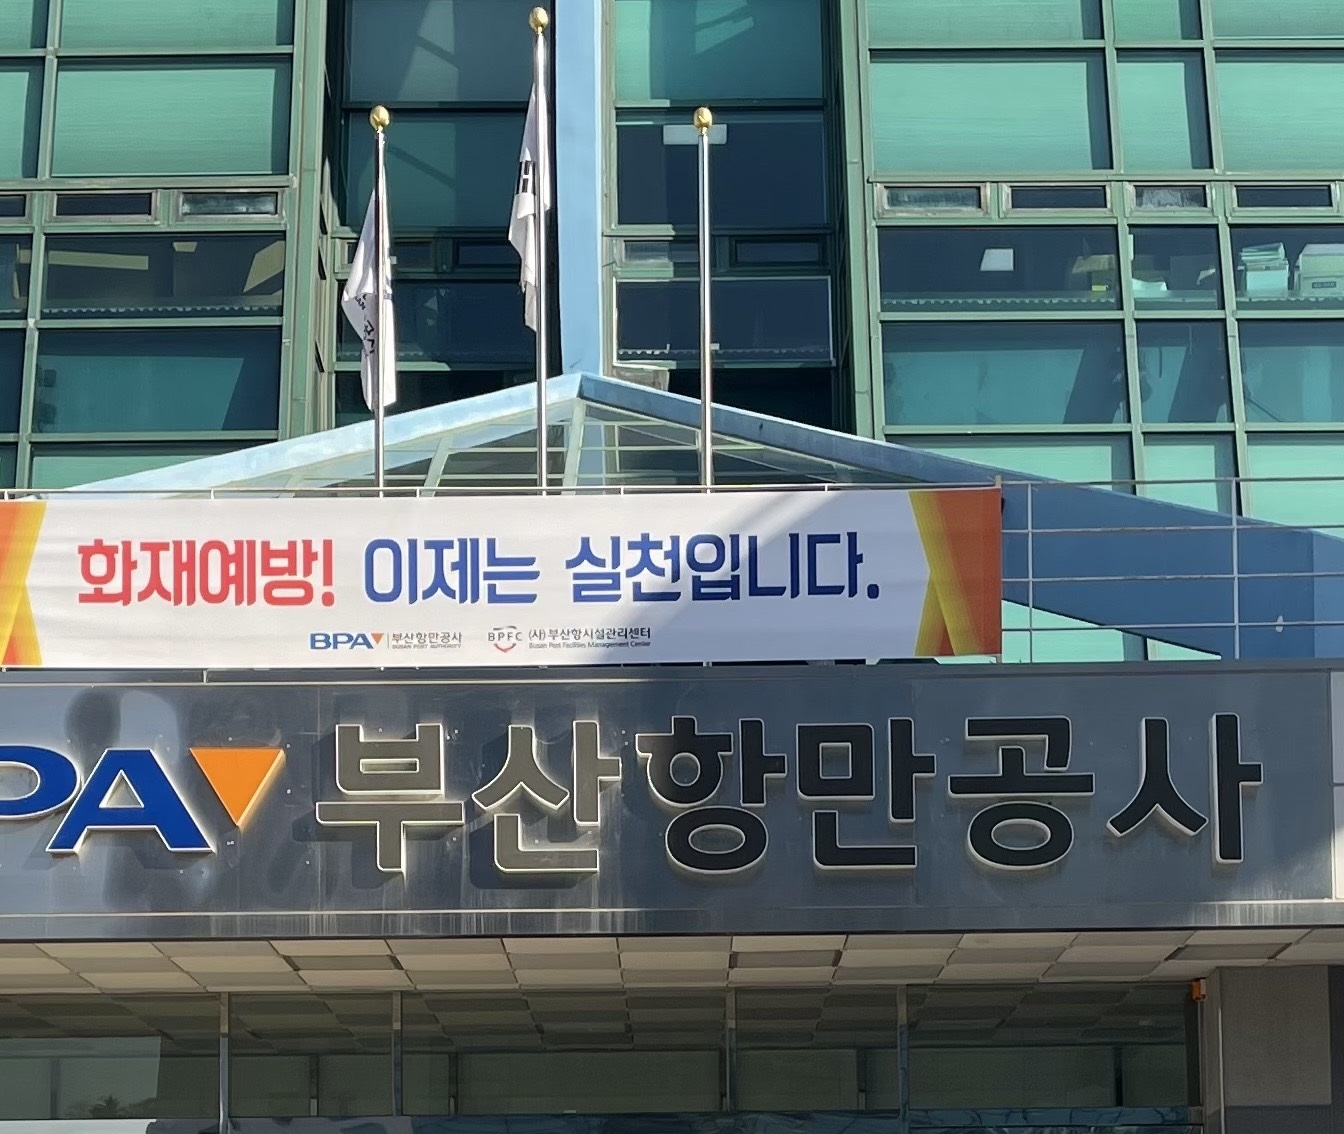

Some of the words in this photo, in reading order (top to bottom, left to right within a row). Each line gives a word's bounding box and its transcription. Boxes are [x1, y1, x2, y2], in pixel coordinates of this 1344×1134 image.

[78, 538, 336, 607] 화재예방!
[365, 535, 539, 603] 이제는
[567, 531, 880, 602] 실천입니다.
[309, 632, 375, 650] BPA
[392, 632, 463, 644] 부산항만공사
[487, 631, 524, 642] BPFC
[315, 712, 1264, 874] 부산항만공사
